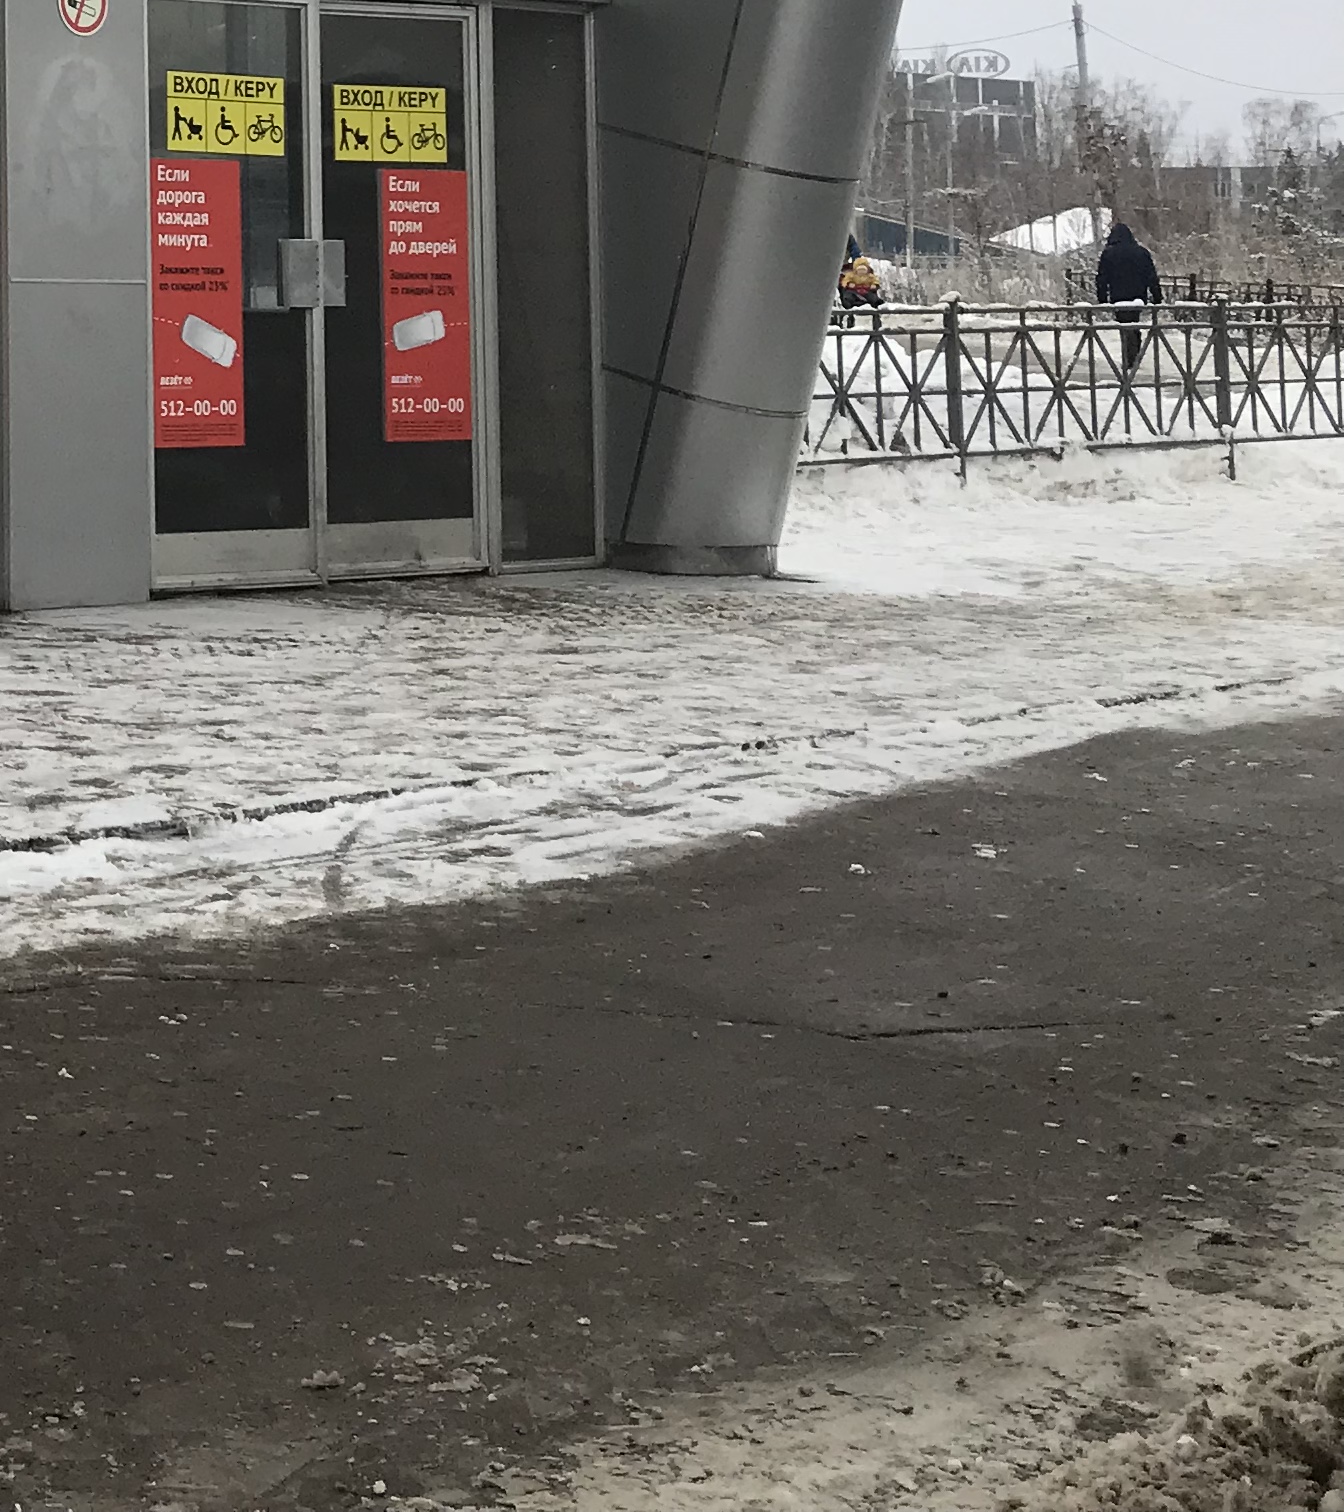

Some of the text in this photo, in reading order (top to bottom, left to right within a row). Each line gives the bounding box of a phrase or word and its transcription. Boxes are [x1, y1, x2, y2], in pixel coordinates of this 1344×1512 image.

[172, 76, 278, 99] ВХОД / КЕРУ
[340, 89, 440, 110] ВХОД / КЕРУ
[158, 165, 189, 181] Если
[389, 176, 419, 192] Если
[157, 191, 205, 207] дорога
[389, 201, 439, 213] хочется
[158, 212, 208, 227] каждая
[390, 221, 422, 236] прям
[158, 232, 207, 249] минута
[389, 239, 457, 257] до дверей
